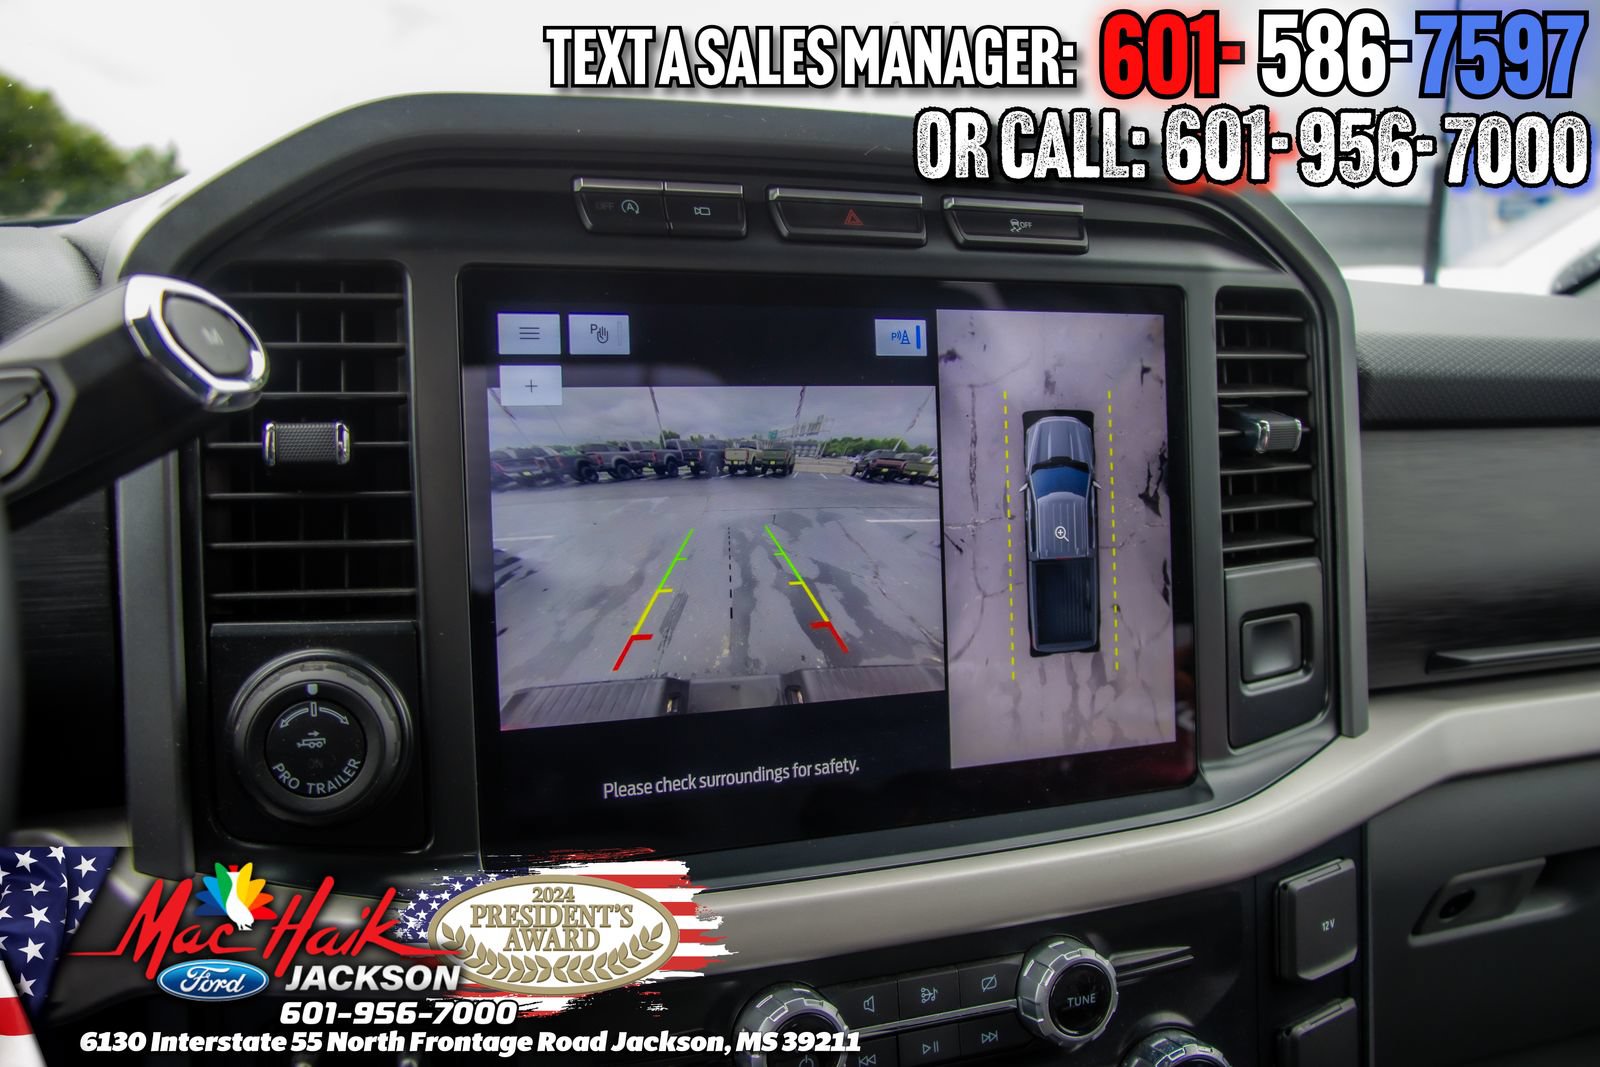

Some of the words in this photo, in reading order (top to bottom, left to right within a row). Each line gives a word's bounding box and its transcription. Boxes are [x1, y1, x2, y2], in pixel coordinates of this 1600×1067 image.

[1019, 221, 1032, 229] OFF
[272, 762, 300, 790] PRO
[306, 757, 361, 795] TRAILER
[603, 781, 652, 799] Please
[655, 774, 697, 793] check
[699, 765, 790, 788] surroundings
[792, 762, 812, 778] for
[814, 757, 860, 776] safety.
[1067, 992, 1097, 1008] TUNE
